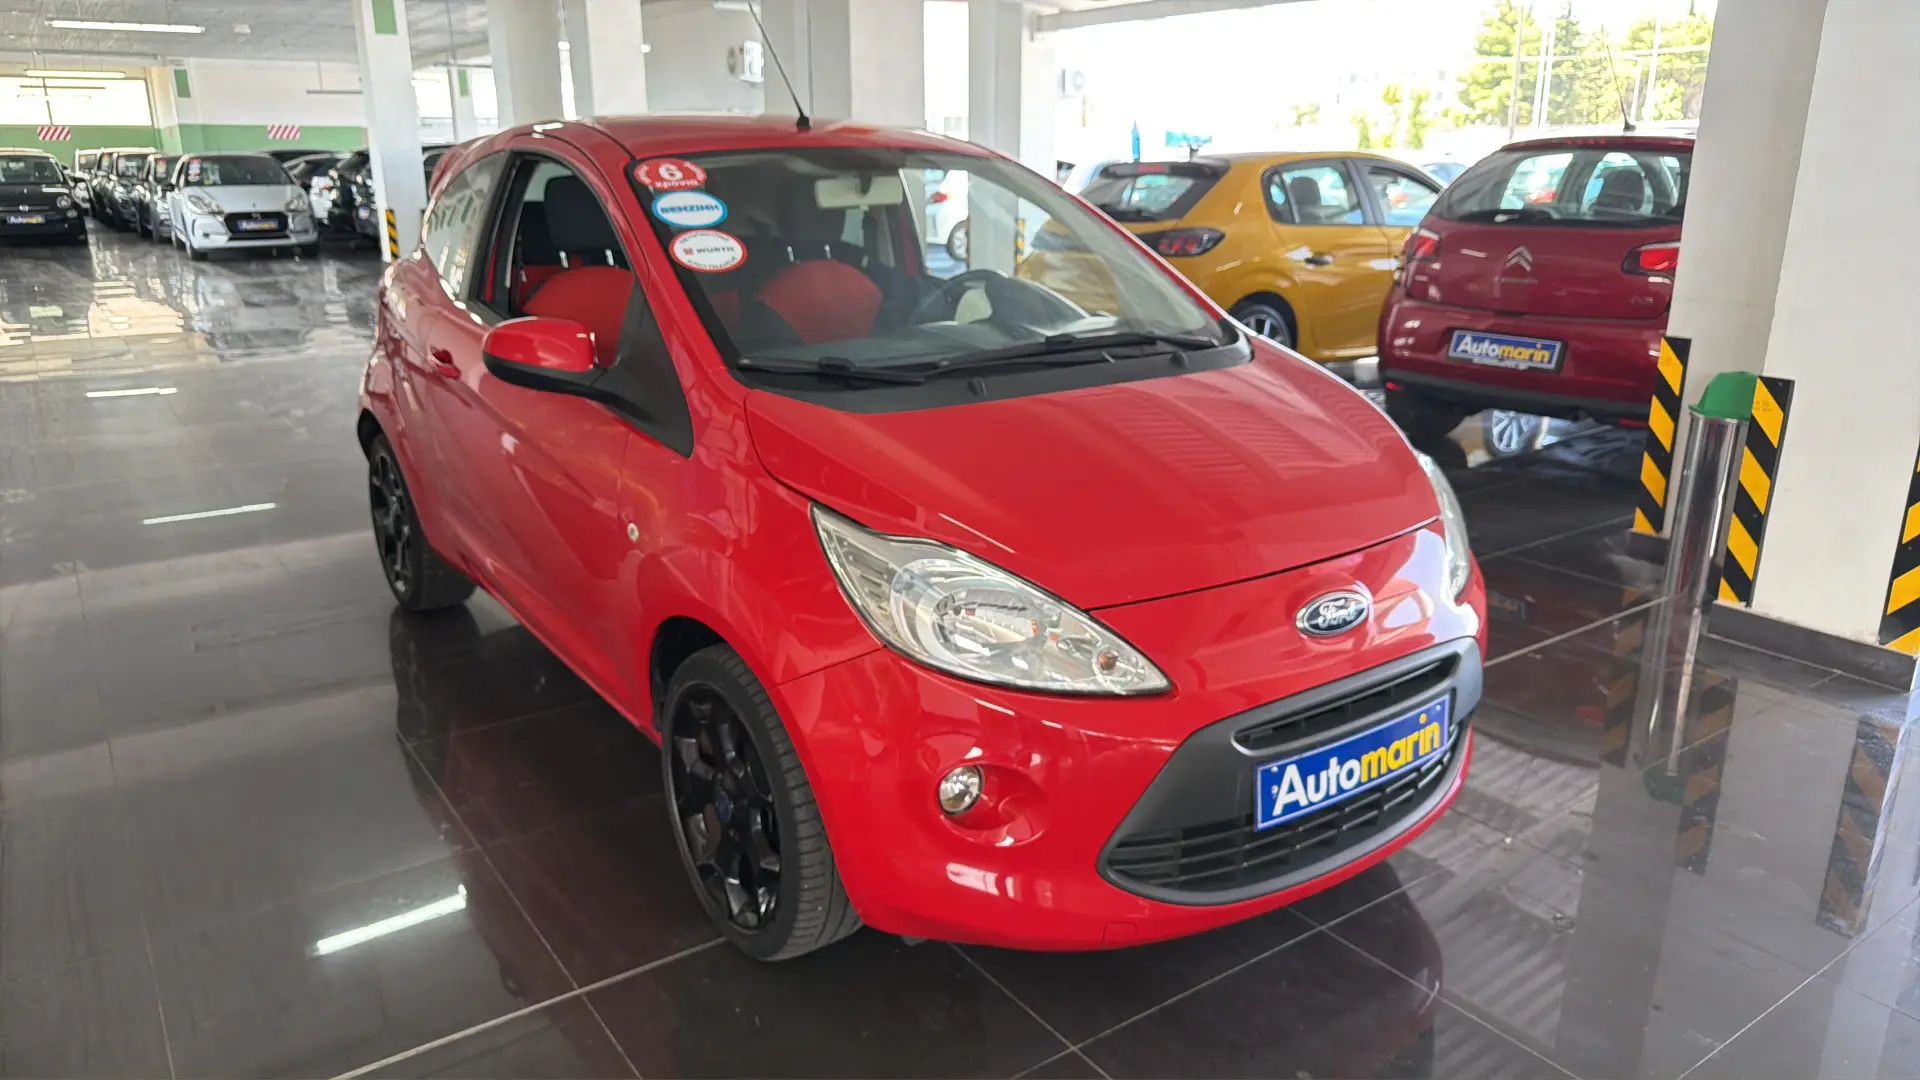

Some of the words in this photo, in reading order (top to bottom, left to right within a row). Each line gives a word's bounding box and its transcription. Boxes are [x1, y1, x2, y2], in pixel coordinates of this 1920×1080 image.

[658, 163, 683, 181] 6
[1455, 333, 1552, 364] Automarin
[1310, 598, 1361, 629] Ford
[1271, 712, 1441, 817] Automarin
